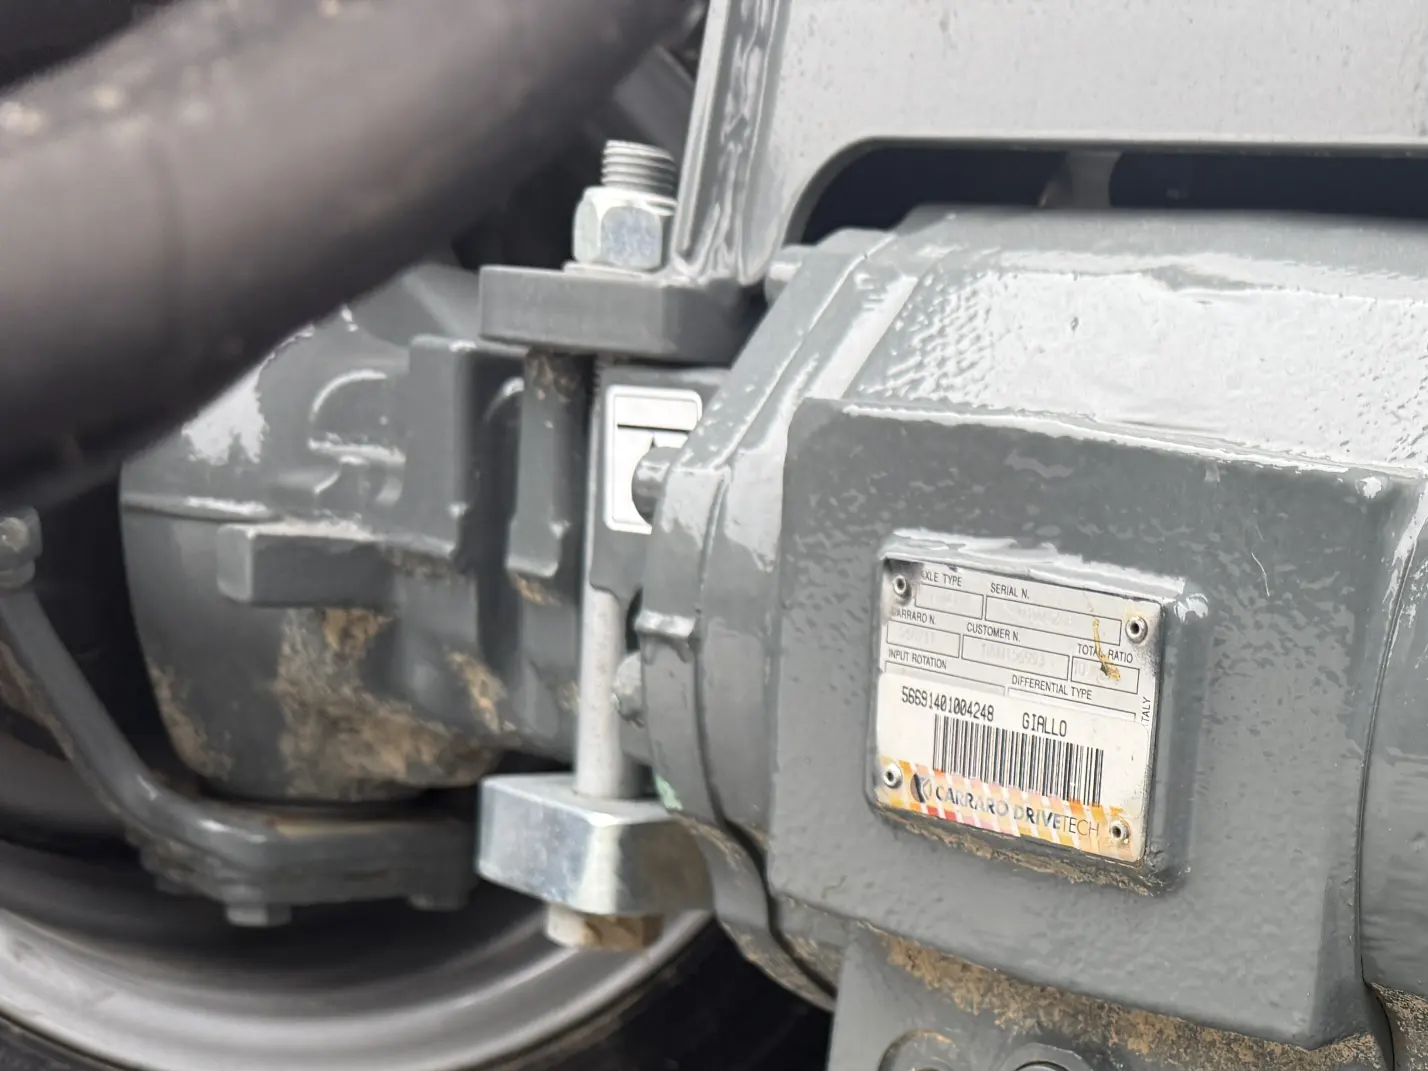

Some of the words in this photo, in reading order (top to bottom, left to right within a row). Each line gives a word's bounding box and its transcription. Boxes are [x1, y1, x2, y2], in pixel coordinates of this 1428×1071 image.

[943, 573, 963, 587] TYPE
[990, 582, 1018, 597] SERIAL
[1021, 587, 1030, 599] N.
[929, 615, 937, 625] N.
[966, 621, 1010, 639] CUSTOMER
[1012, 630, 1021, 642] N.
[888, 648, 909, 662] INPUT
[912, 653, 947, 670] ROTATION
[1108, 648, 1133, 664] RATIO
[1011, 674, 1068, 696] DIFFERENTIAL
[1071, 685, 1093, 701] TYPE
[900, 685, 995, 722] 56691401004248
[1021, 711, 1068, 738] GIALLO
[1140, 696, 1151, 726] TALY
[935, 785, 1009, 818] CARRARO
[1013, 806, 1100, 839] DRIVETECH
